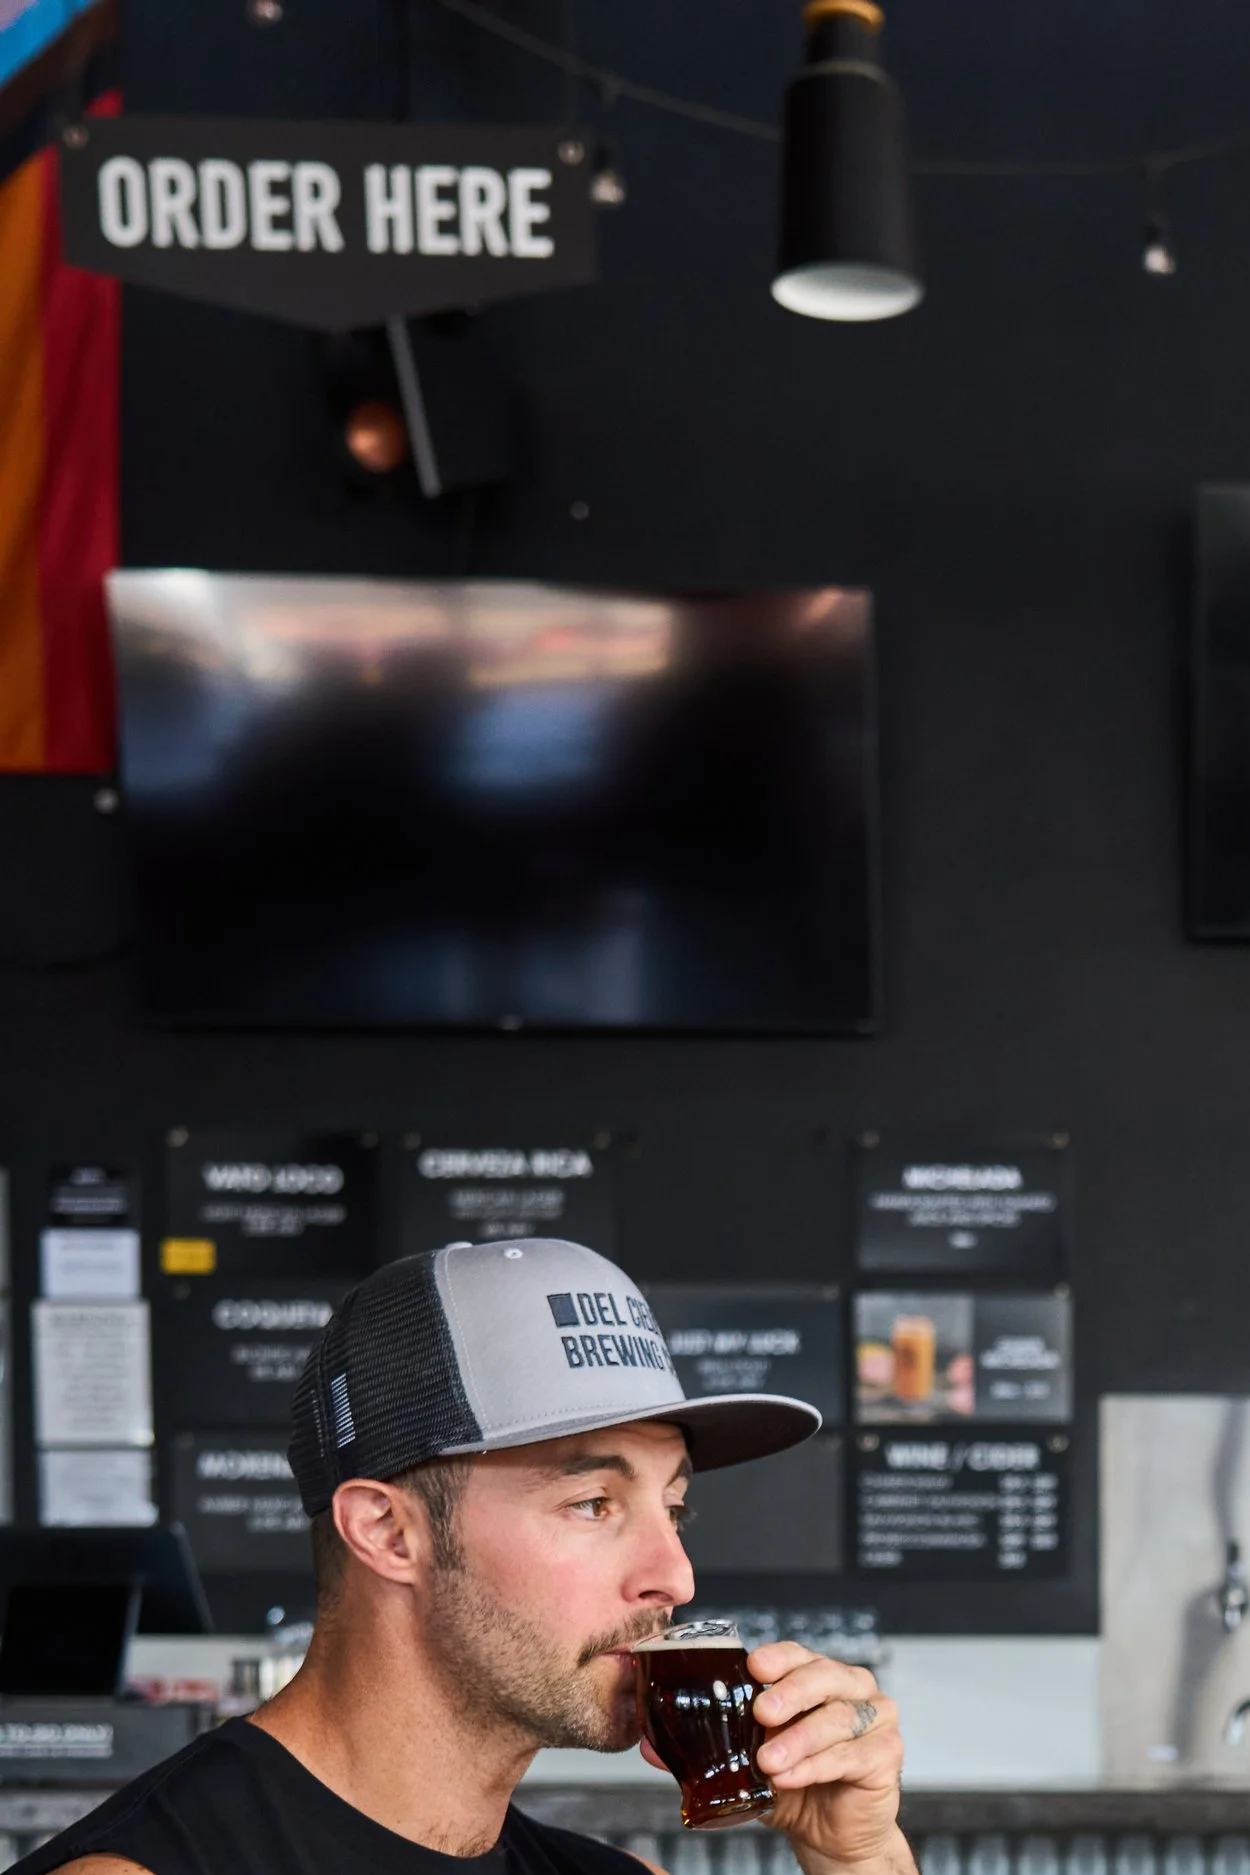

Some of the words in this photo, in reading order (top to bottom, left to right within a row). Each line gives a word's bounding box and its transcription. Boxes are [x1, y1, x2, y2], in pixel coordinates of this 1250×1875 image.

[98, 155, 345, 253] ORDER
[363, 162, 555, 259] HERE
[272, 1162, 345, 1194] LOCO
[577, 1293, 627, 1326] DEL
[561, 1334, 665, 1370] BREWING
[885, 1440, 949, 1470] WINE
[968, 1441, 1041, 1471] CIDER
